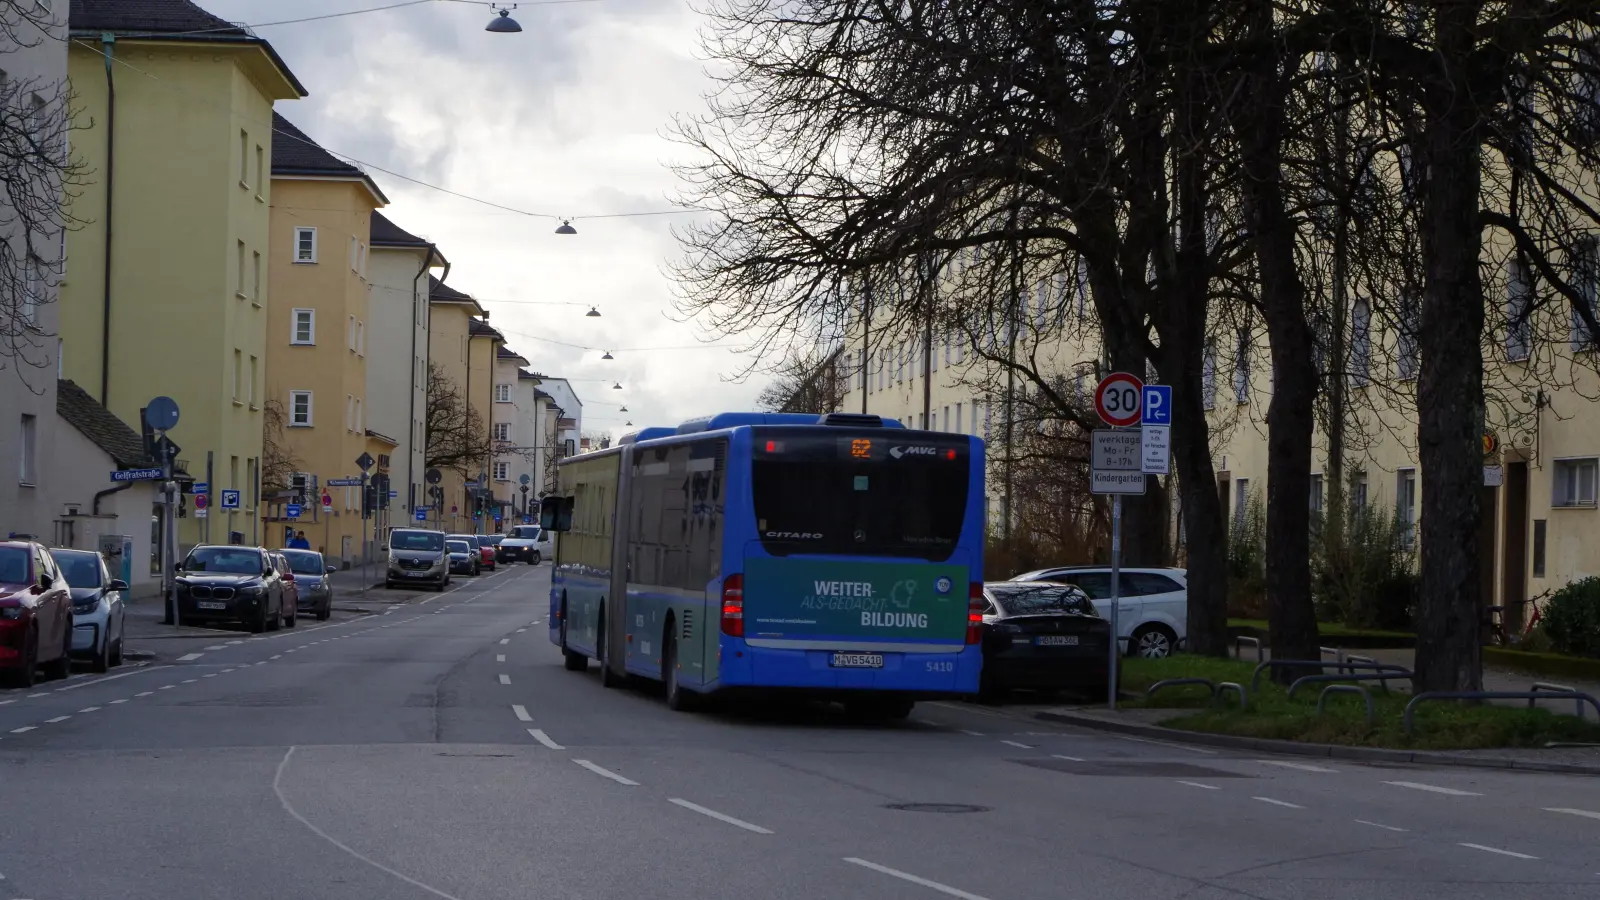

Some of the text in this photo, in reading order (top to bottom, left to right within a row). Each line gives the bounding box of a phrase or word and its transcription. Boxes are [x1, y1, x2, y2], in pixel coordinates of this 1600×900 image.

[1106, 388, 1136, 412] 30
[1146, 390, 1163, 419] P
[1098, 435, 1140, 445] werktags
[904, 446, 937, 456] MVG
[1103, 446, 1117, 455] Mo
[1124, 446, 1135, 455] Fr
[1094, 473, 1142, 484] Kindergarten
[765, 530, 826, 540] CITARO
[814, 580, 877, 598] WEITER-
[860, 612, 928, 628] BILDUNG
[925, 661, 953, 672] 5410
